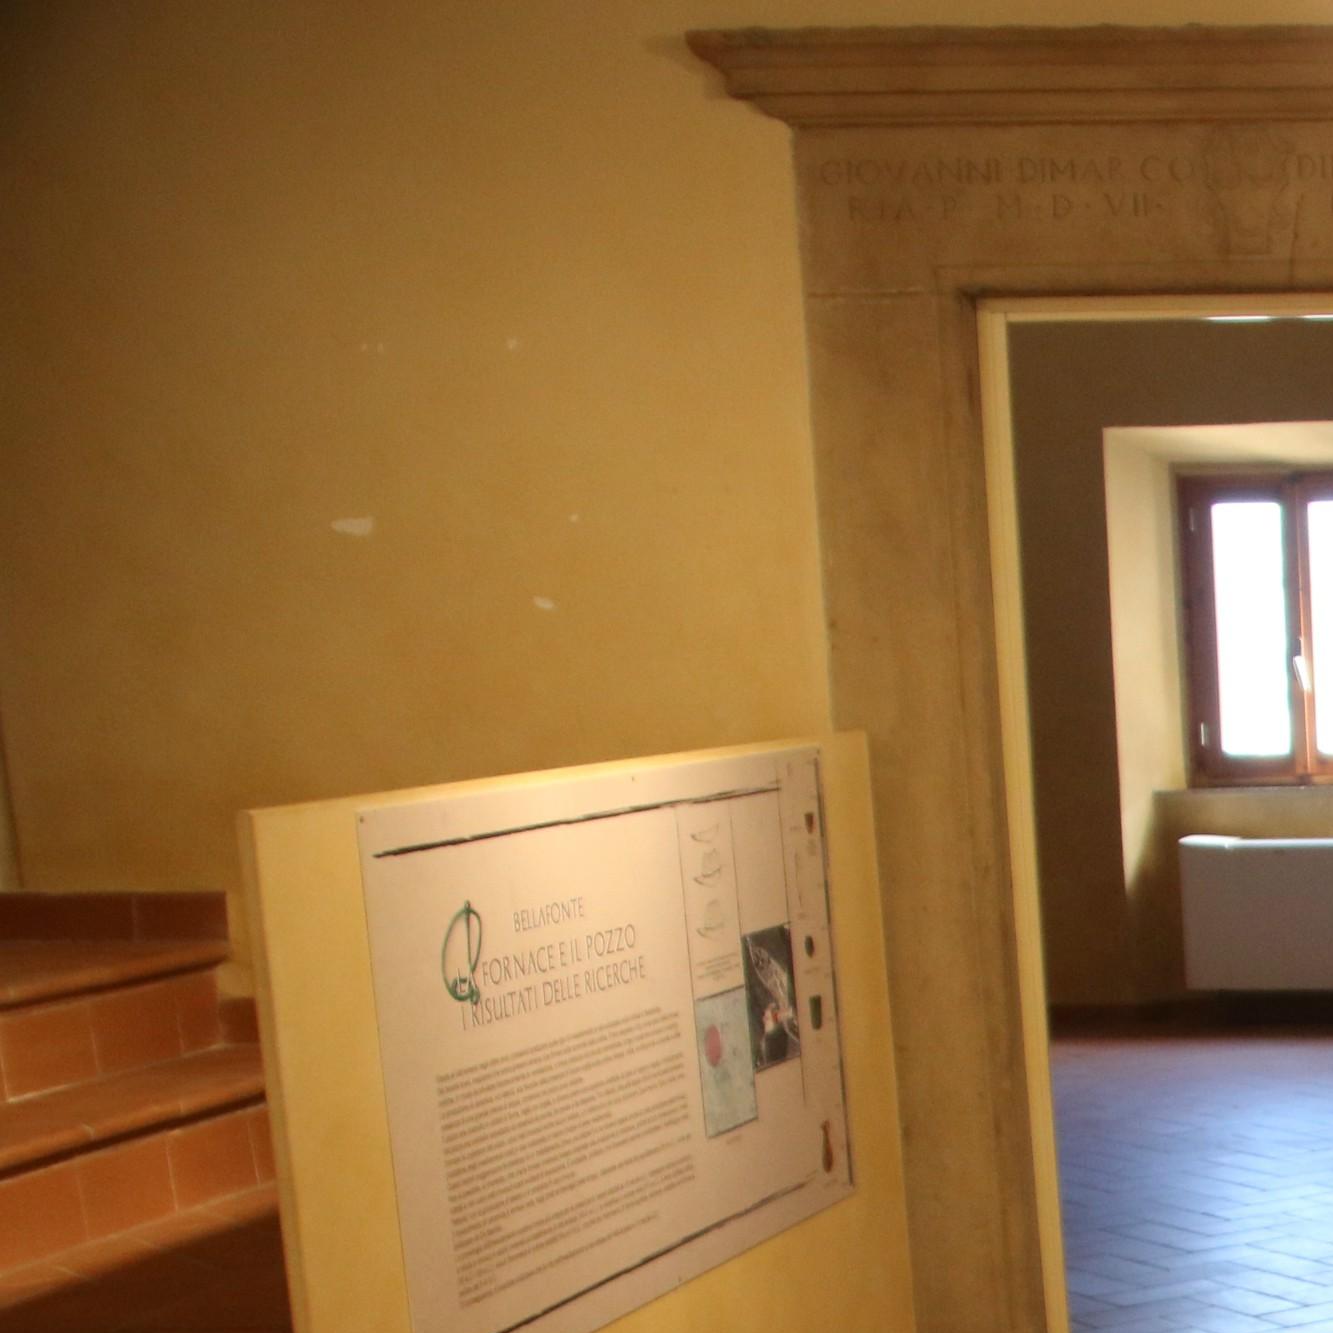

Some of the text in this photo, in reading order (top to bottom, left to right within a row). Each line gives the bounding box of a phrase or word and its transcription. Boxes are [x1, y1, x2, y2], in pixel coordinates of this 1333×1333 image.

[513, 897, 585, 933] BELLAFONTE
[482, 944, 555, 986] FORNACE
[559, 941, 567, 967] E
[571, 938, 582, 965] IL
[586, 924, 637, 960] POZZO
[470, 987, 539, 1028] RISULTATI
[543, 974, 581, 1006] DELLE
[584, 956, 646, 994] RICERCHE
